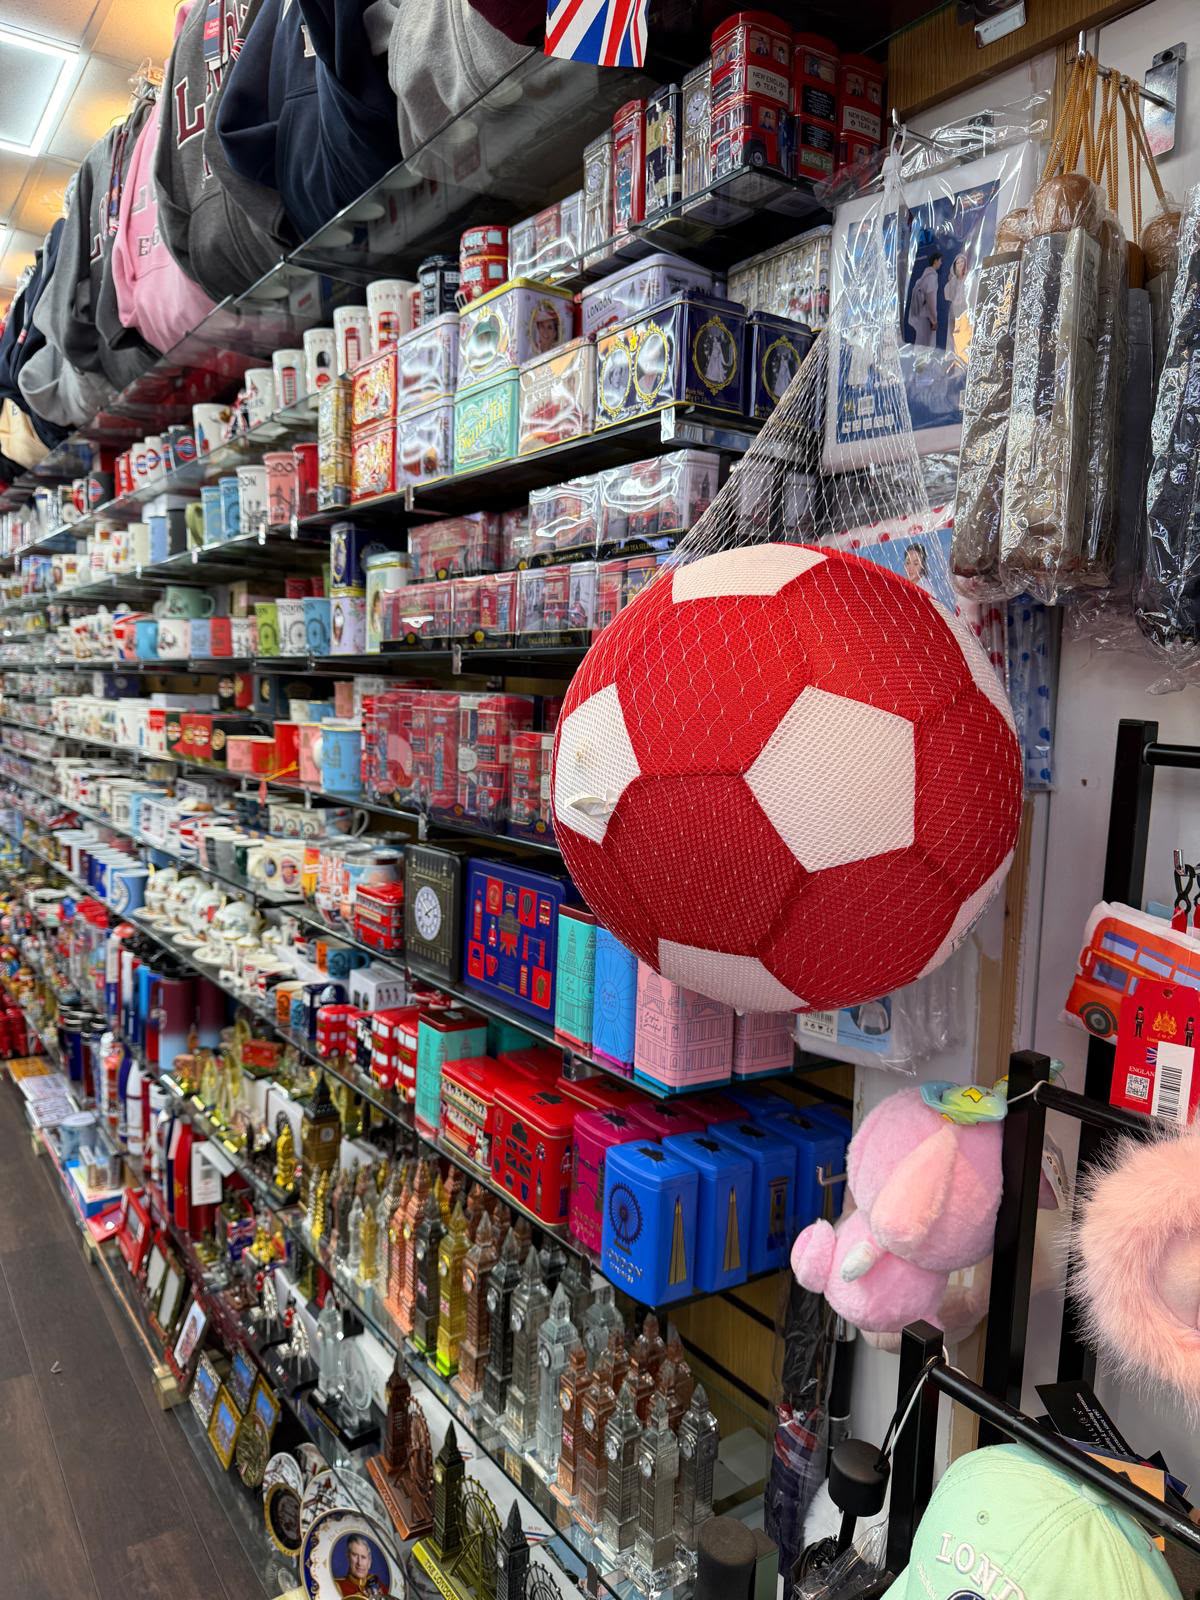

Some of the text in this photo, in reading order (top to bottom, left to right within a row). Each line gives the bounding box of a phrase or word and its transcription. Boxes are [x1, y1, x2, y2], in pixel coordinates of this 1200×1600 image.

[752, 71, 786, 89] NEW ENGLISH
[763, 82, 779, 94] TEAS
[1128, 1065, 1155, 1078] ENGLAN
[606, 1247, 643, 1276] ONDON
[424, 1559, 437, 1575] THE
[935, 1531, 1027, 1600] LOND
